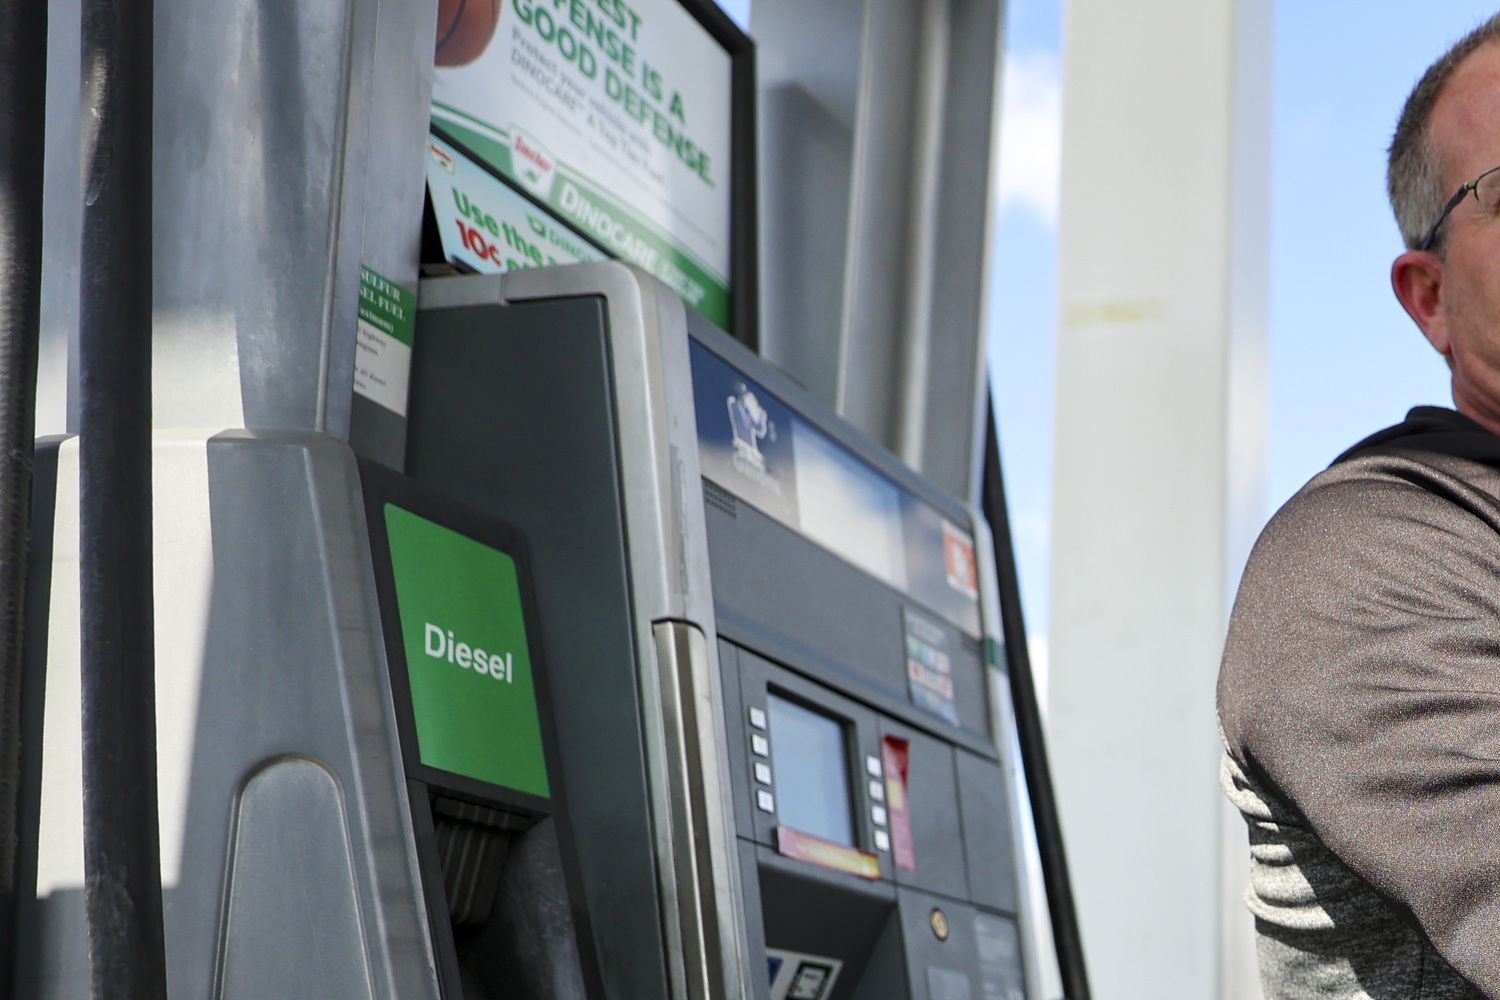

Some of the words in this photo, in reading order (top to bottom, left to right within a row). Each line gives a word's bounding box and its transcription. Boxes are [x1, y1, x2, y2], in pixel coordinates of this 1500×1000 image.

[512, 0, 597, 81] GOOD
[642, 61, 662, 101] IS
[669, 90, 686, 126] A
[452, 187, 499, 239] Use
[502, 222, 543, 268] the
[424, 622, 512, 683] Diesel
